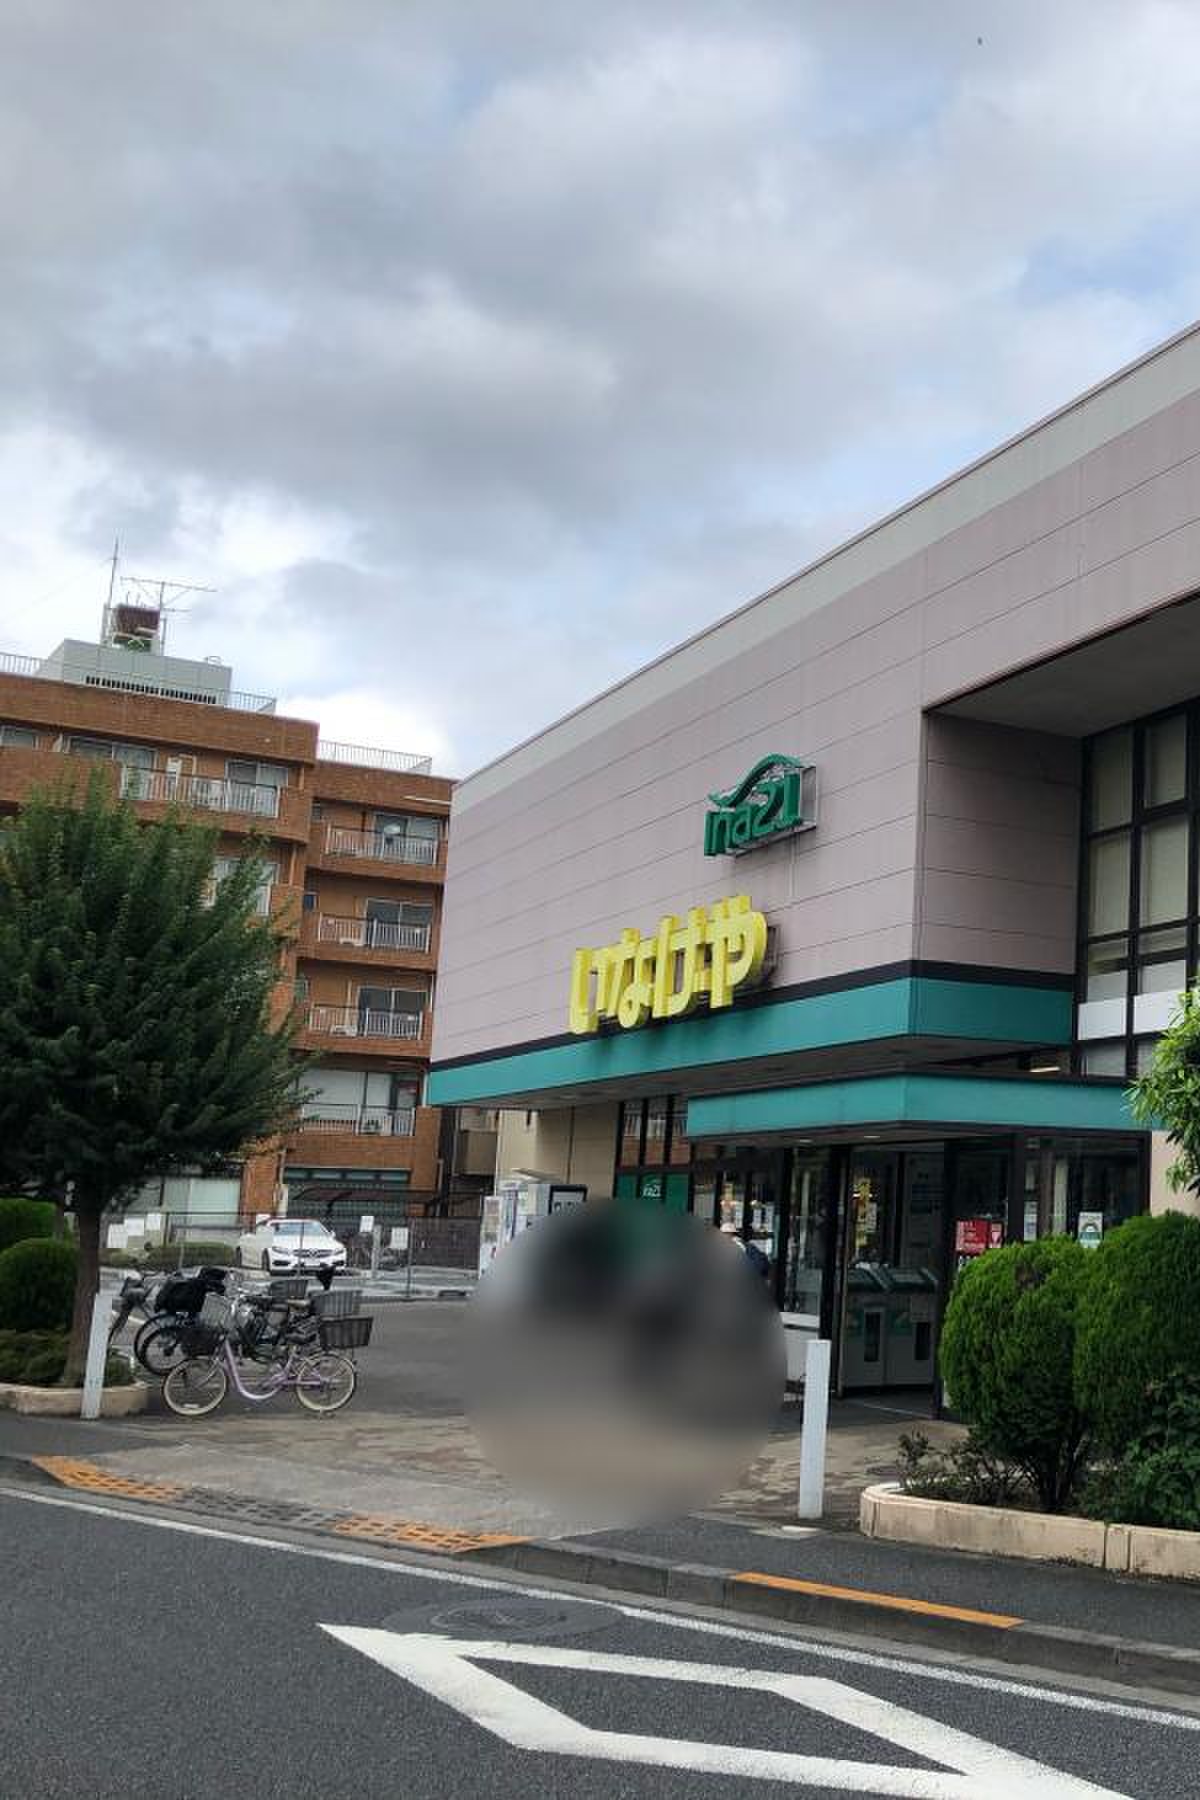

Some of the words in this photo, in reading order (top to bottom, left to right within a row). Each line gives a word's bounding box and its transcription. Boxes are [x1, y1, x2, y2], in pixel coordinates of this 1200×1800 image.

[704, 768, 803, 857] ina21
[570, 896, 768, 1033] いなげや
